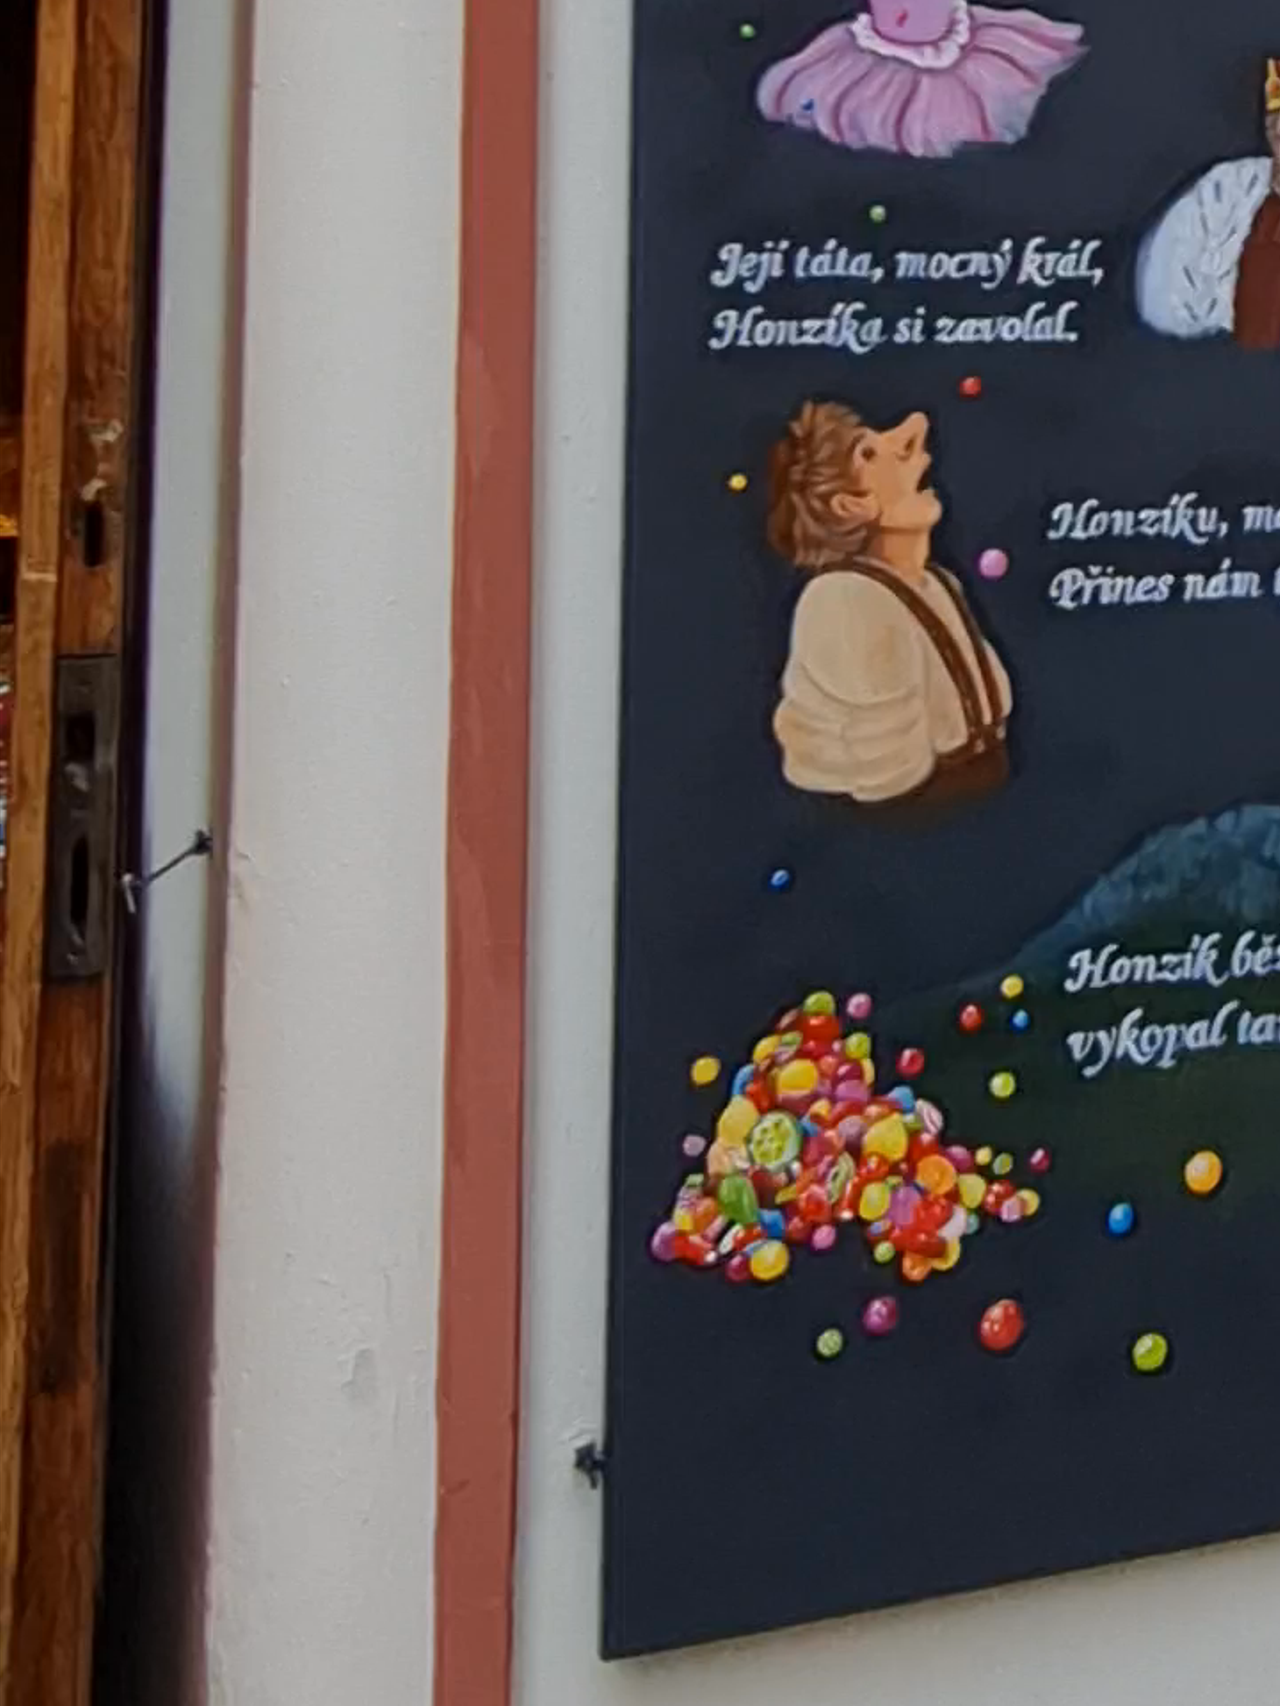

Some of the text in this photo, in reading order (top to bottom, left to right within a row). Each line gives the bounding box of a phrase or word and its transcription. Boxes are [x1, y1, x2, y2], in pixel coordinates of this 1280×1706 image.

[794, 237, 885, 284] táta,
[1015, 235, 1105, 288] král,
[707, 299, 1079, 355] Honzíka si zavolal.
[1046, 491, 1229, 546] Honzíku,
[1048, 564, 1176, 610] Přines
[1182, 556, 1262, 602] nám
[1066, 1000, 1239, 1077] vykopal
